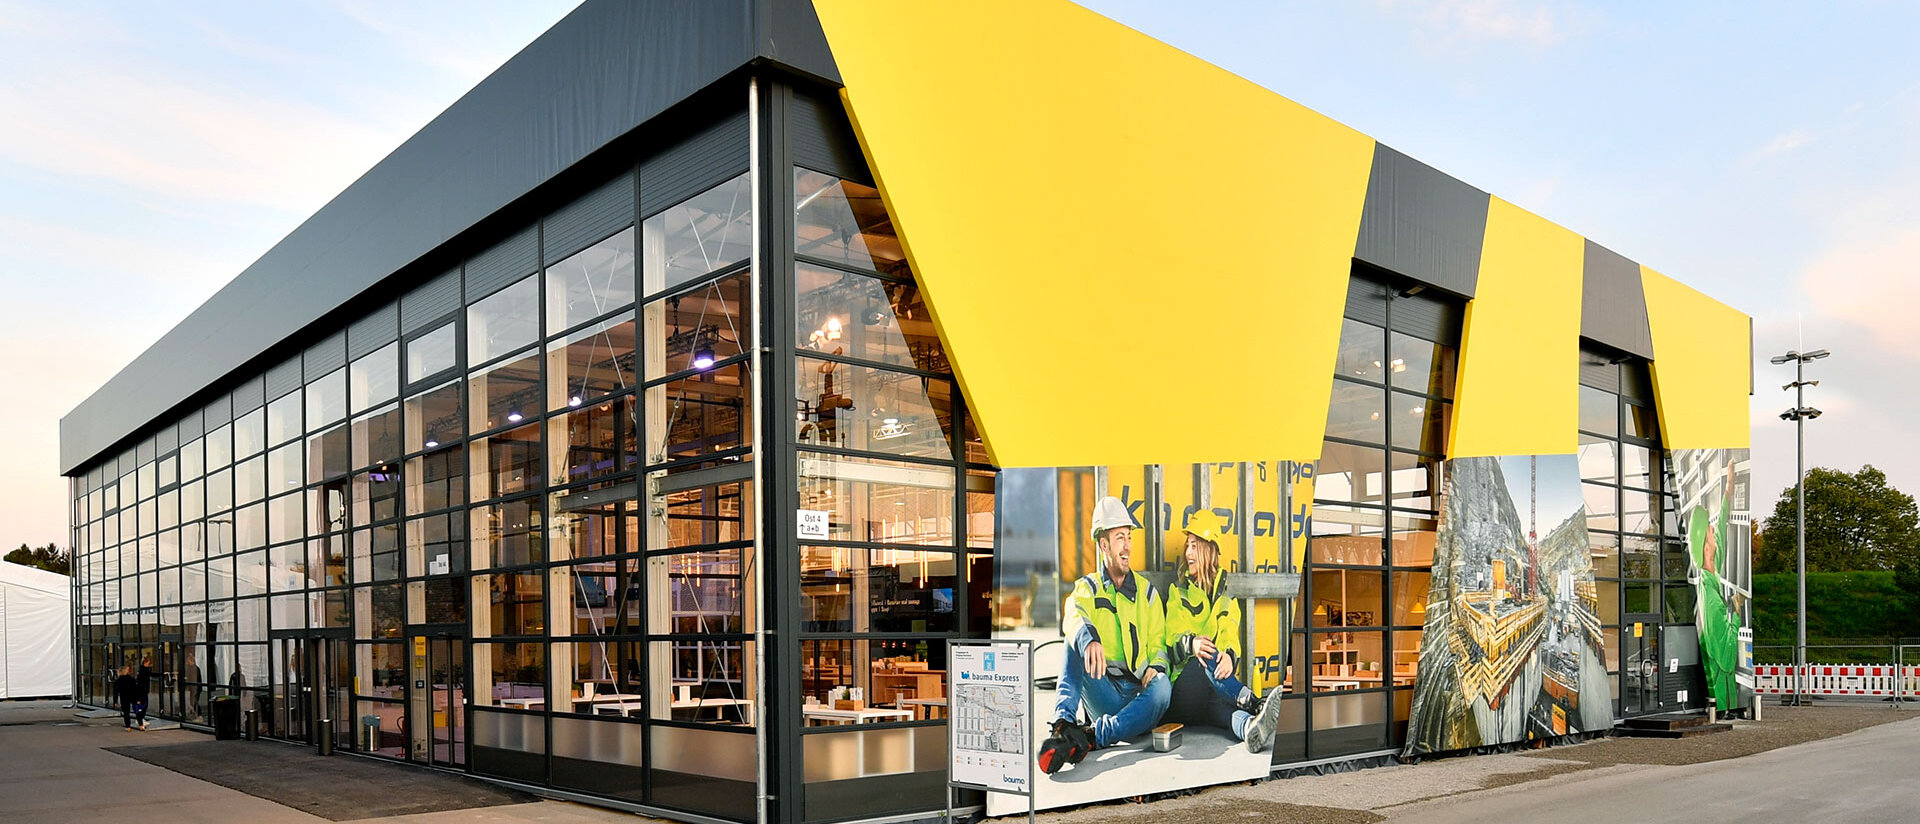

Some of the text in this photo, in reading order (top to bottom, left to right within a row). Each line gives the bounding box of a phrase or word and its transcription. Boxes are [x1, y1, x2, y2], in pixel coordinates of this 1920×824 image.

[804, 514, 816, 523] Ost
[972, 673, 1020, 683] bauma Express
[1003, 773, 1025, 785] bauma
